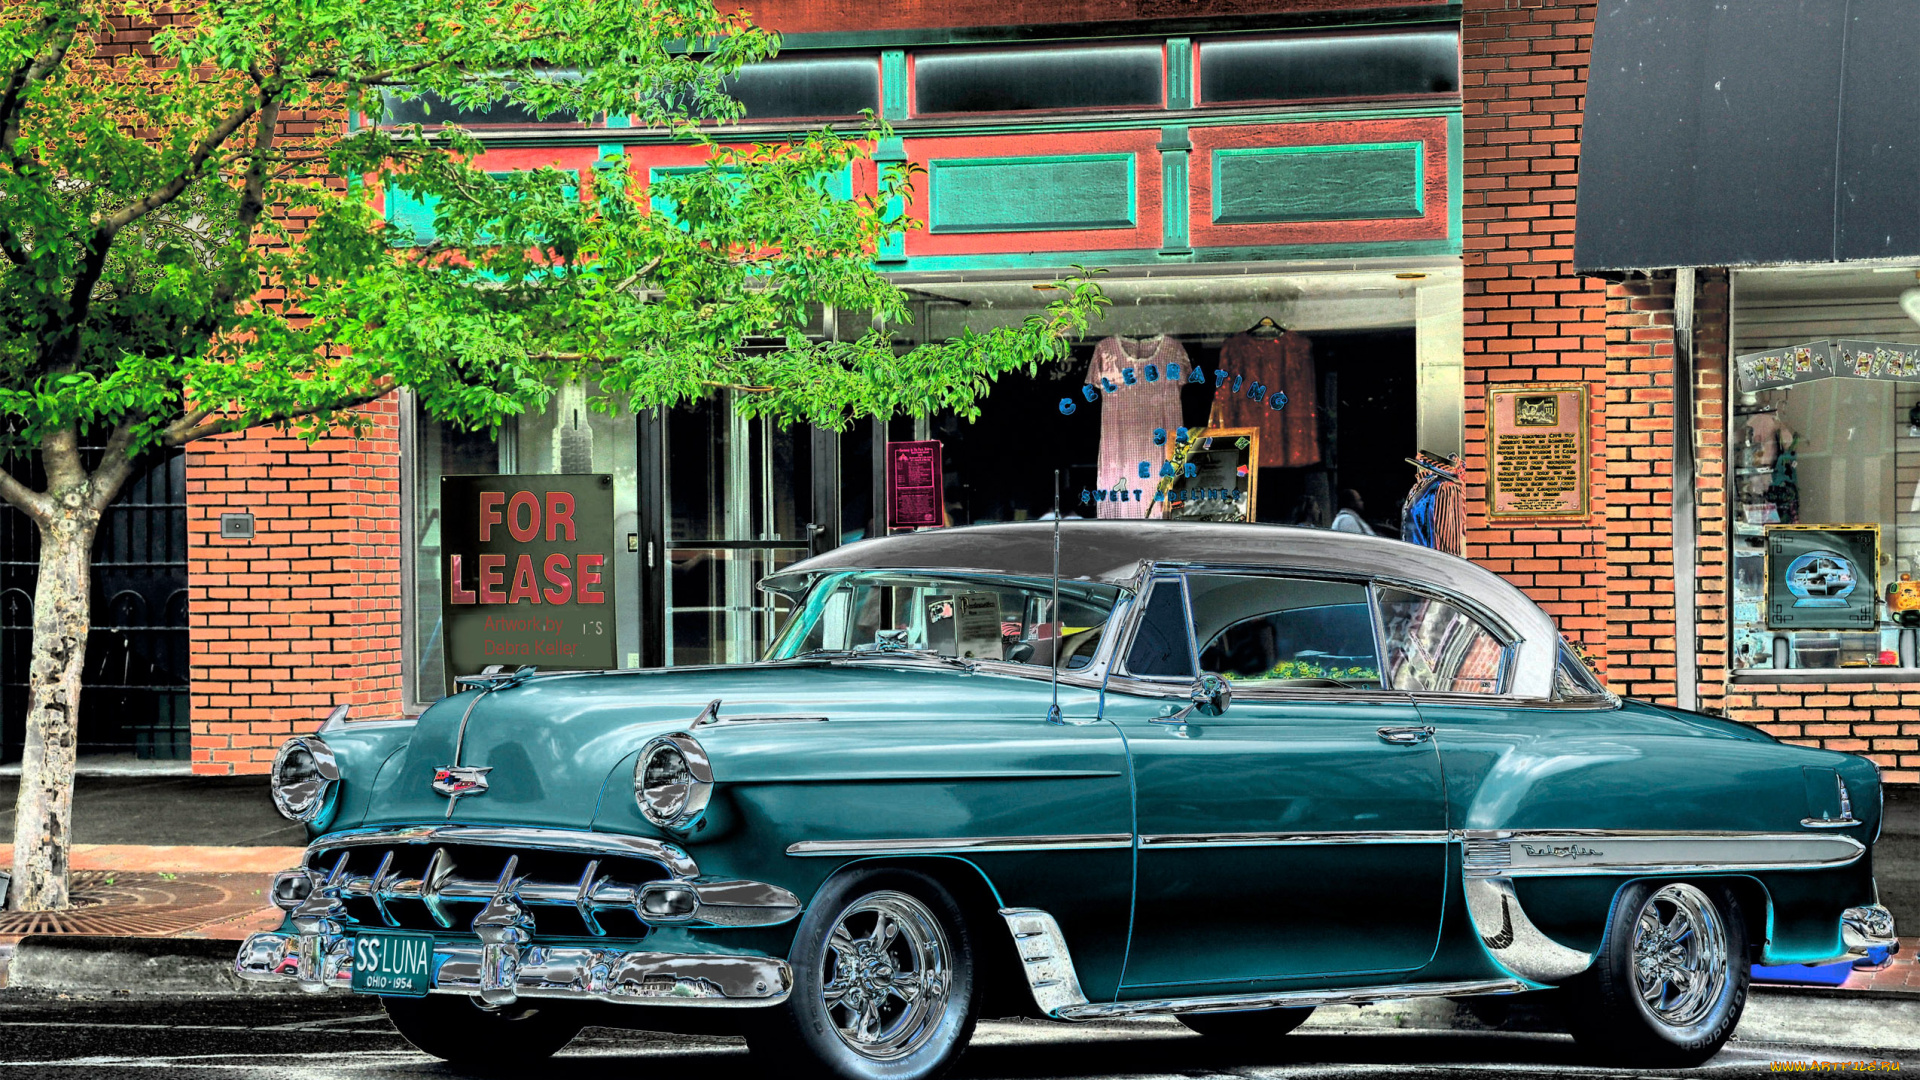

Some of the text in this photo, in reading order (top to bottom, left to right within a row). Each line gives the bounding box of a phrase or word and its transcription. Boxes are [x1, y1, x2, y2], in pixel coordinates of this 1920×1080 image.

[1058, 362, 1288, 416] CELEBRATING
[1153, 426, 1190, 446] 35
[480, 491, 577, 542] FOR
[1081, 488, 1241, 502] SWEET ADELINES
[451, 553, 606, 605] LEASE
